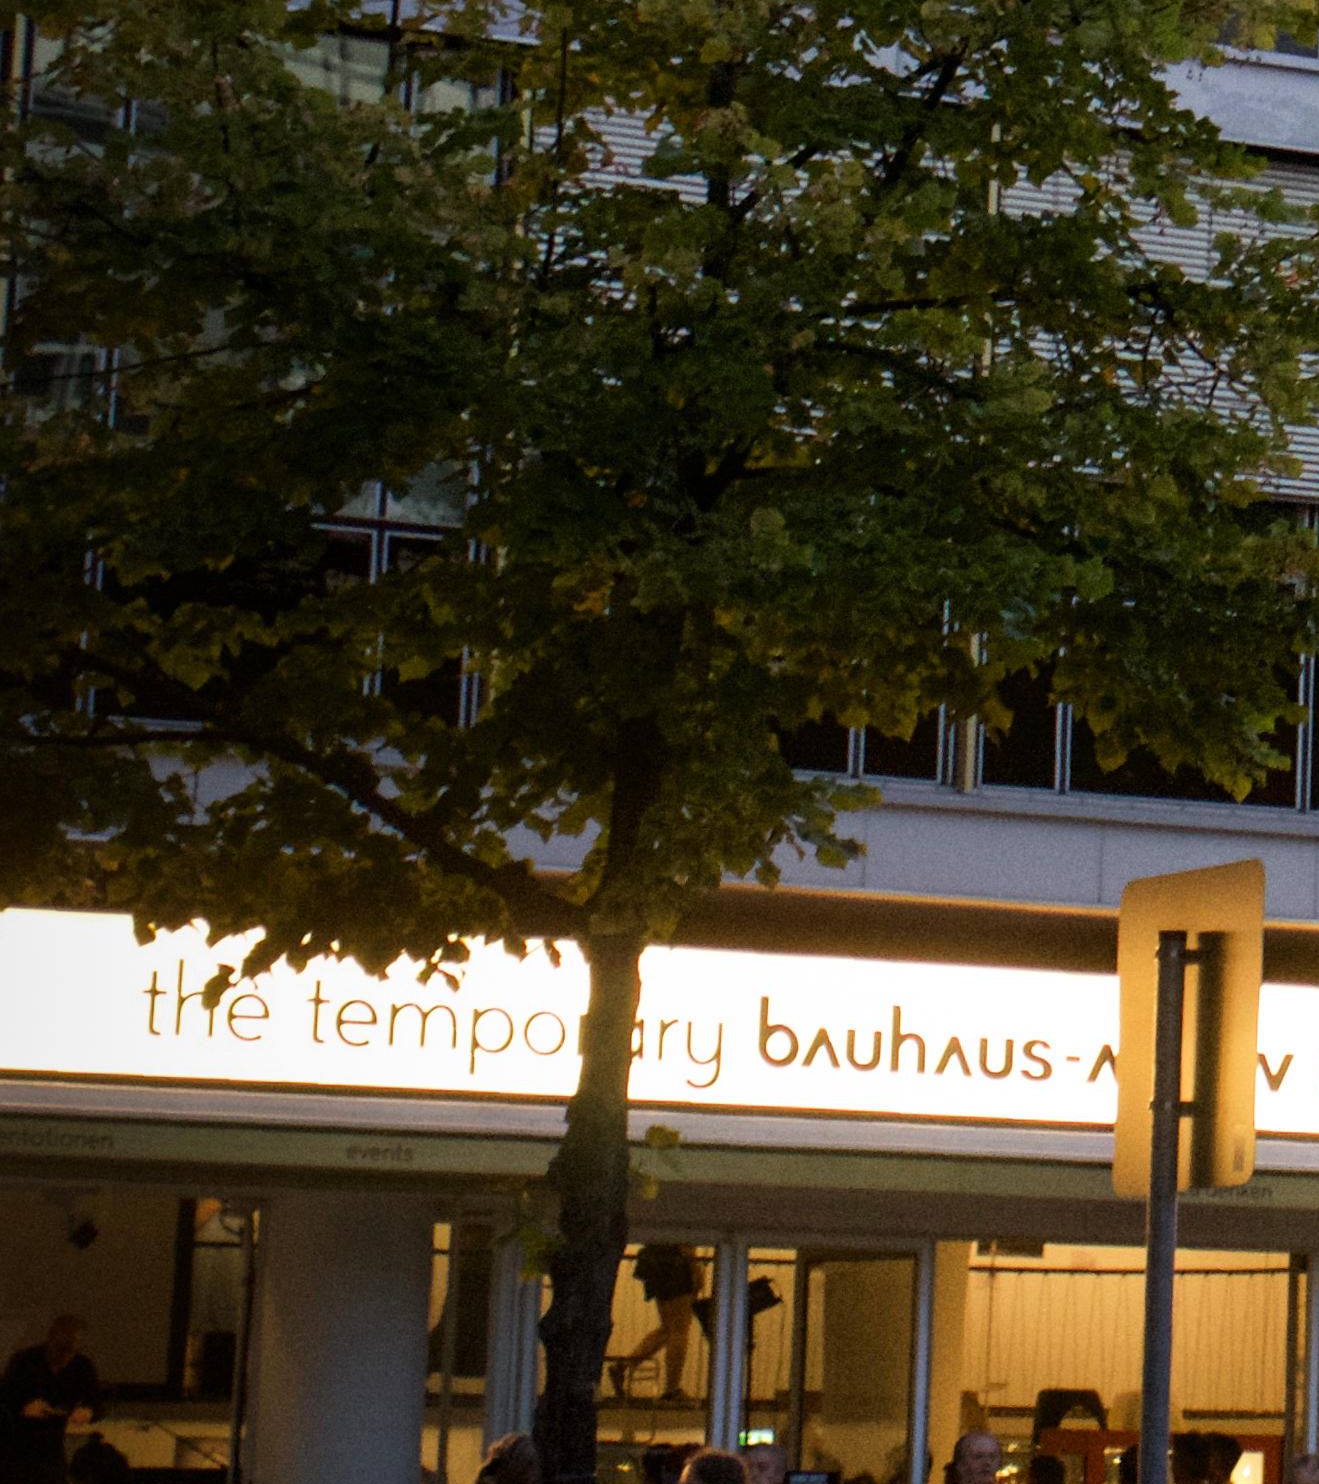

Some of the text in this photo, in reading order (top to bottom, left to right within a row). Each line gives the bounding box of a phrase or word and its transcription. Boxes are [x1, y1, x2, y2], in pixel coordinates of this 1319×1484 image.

[142, 958, 270, 1042] the
[306, 979, 724, 1090] tempoary
[757, 994, 1295, 1093] bauhaus-av
[346, 1143, 413, 1162] events
